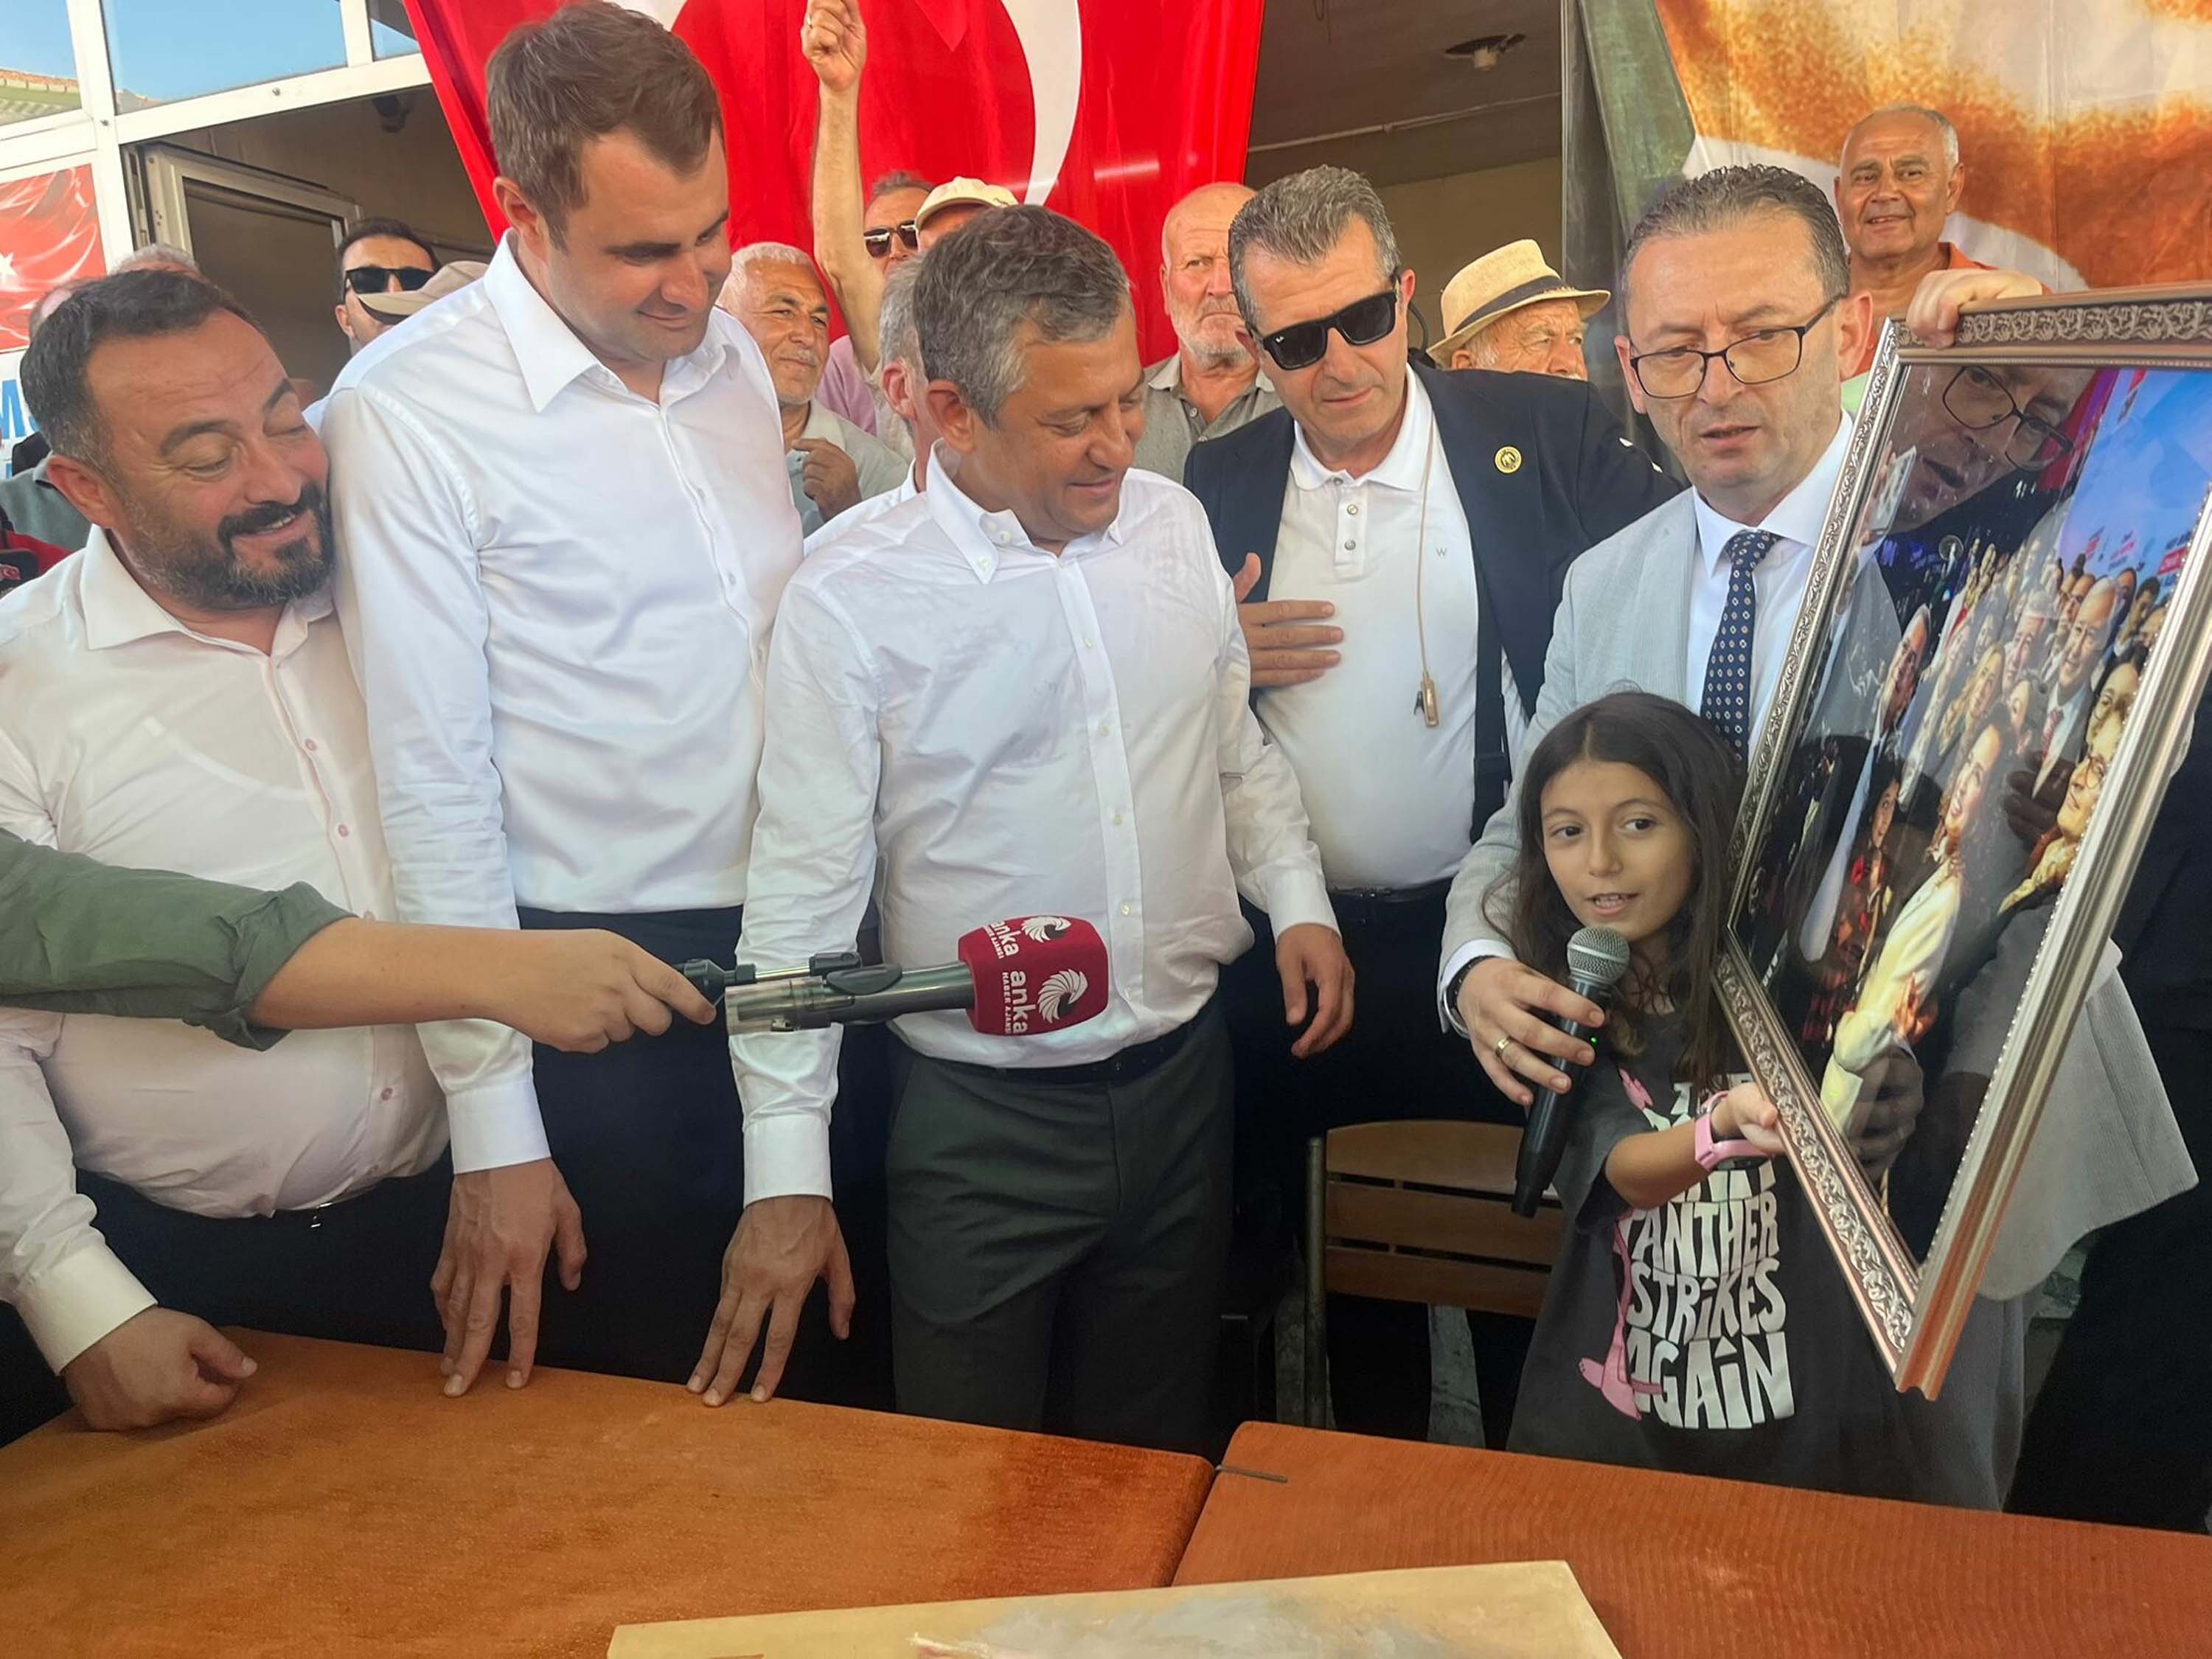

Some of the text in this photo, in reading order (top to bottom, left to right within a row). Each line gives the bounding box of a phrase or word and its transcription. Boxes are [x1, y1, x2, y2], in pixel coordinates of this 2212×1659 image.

[990, 921, 1021, 956] anka
[1002, 971, 1011, 1004] HABER
[1010, 970, 1037, 1034] anka
